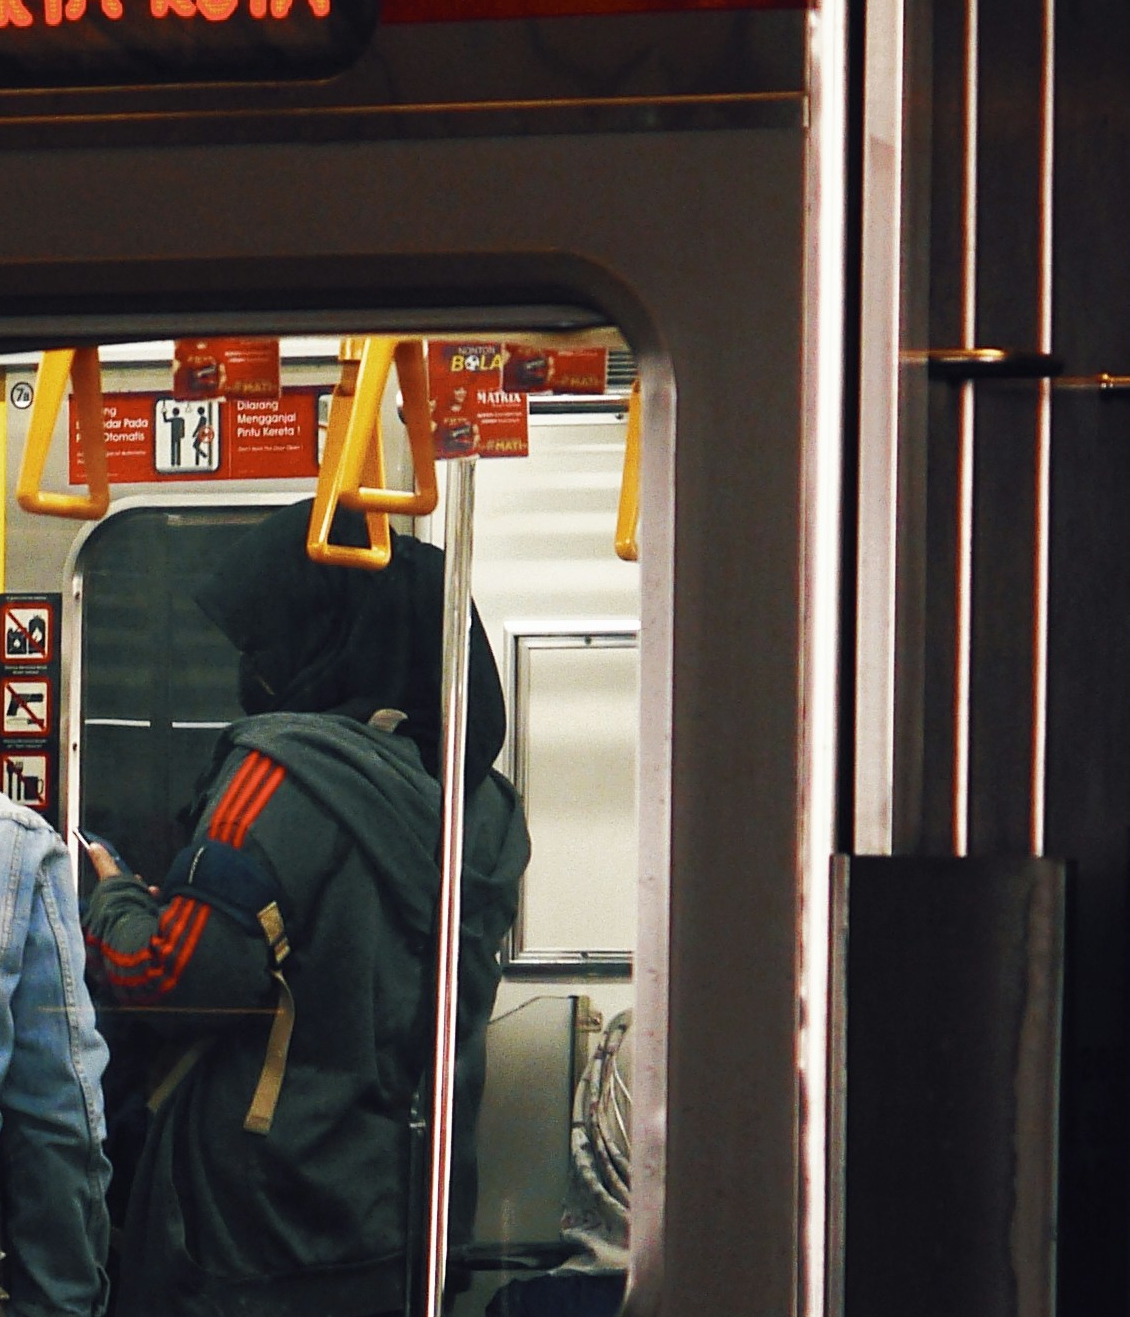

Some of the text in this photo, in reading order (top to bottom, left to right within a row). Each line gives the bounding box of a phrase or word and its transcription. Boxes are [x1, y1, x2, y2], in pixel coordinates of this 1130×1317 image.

[476, 390, 522, 404] MATRIX
[236, 400, 279, 412] Dilarang
[123, 418, 149, 429] Pada
[236, 413, 297, 426] Mengganjal
[236, 427, 261, 438] Pintu
[262, 425, 295, 437] Kereta
